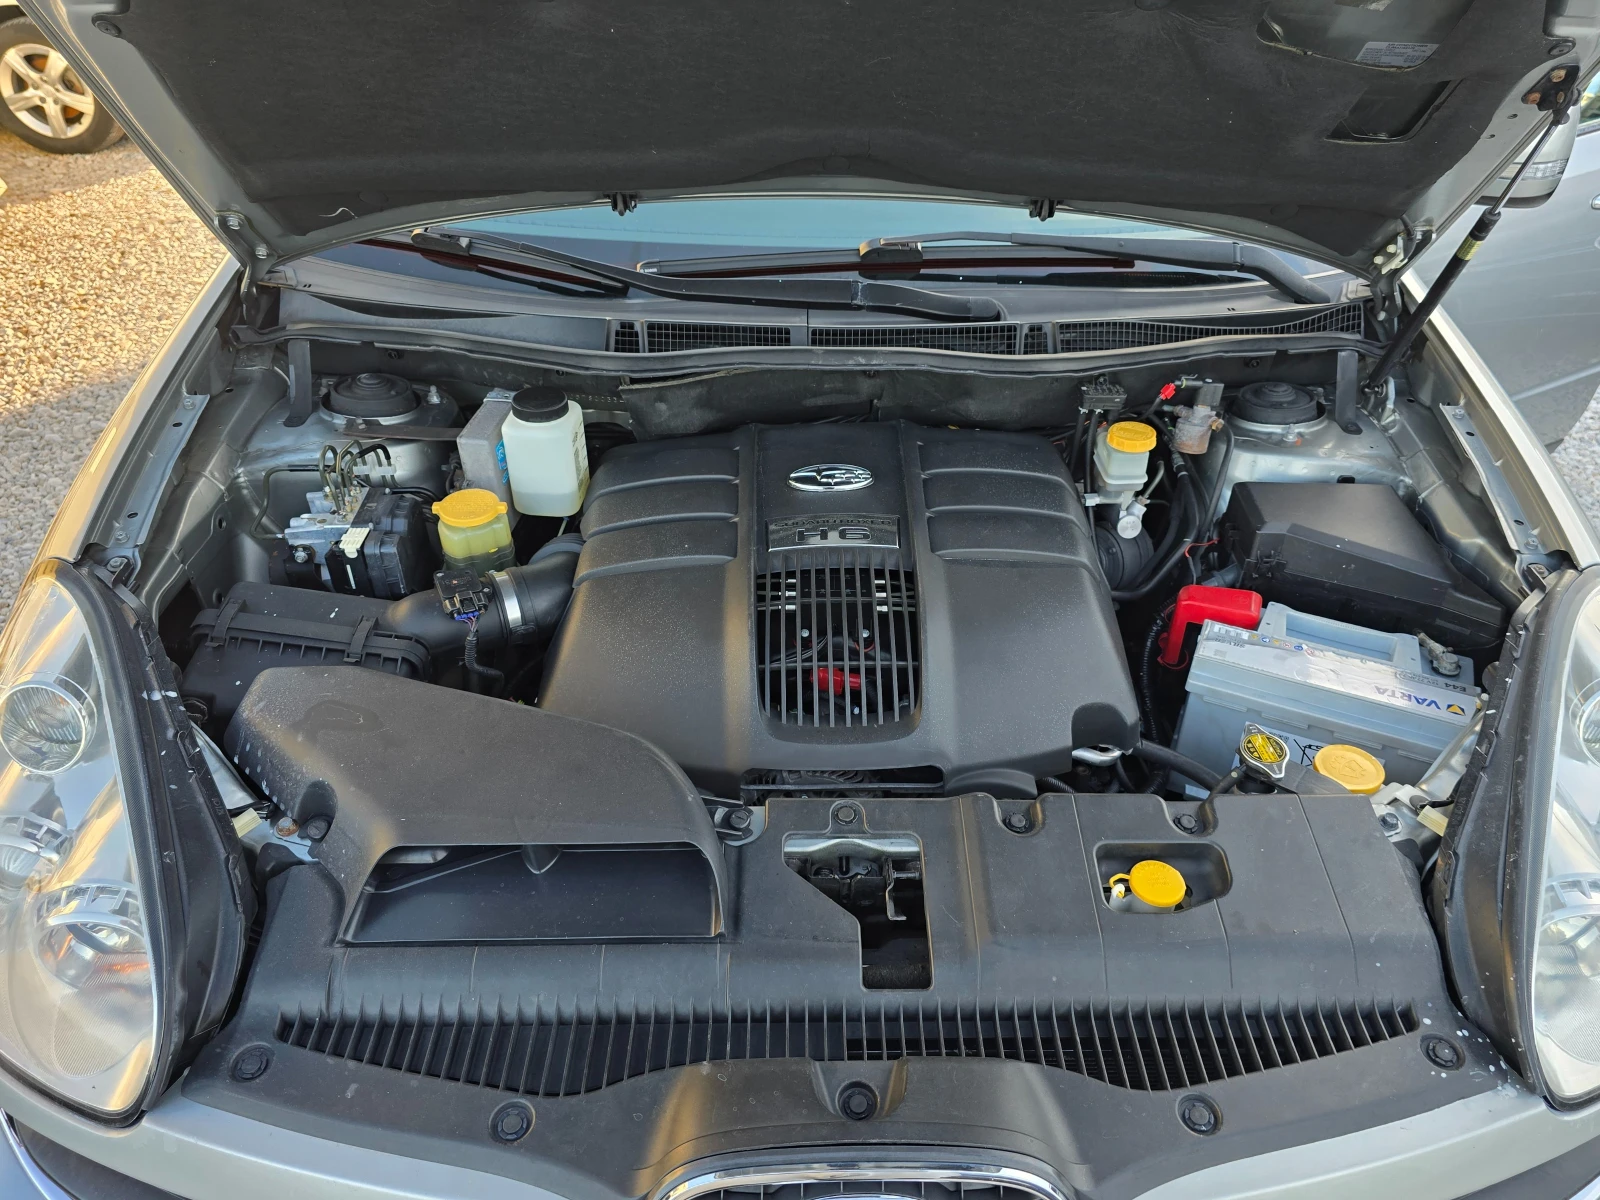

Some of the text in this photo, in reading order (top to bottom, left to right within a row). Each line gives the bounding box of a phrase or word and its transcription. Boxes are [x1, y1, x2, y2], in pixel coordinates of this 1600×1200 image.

[796, 527, 871, 543] H6
[1443, 682, 1467, 693] E44
[1374, 684, 1442, 710] VARTA
